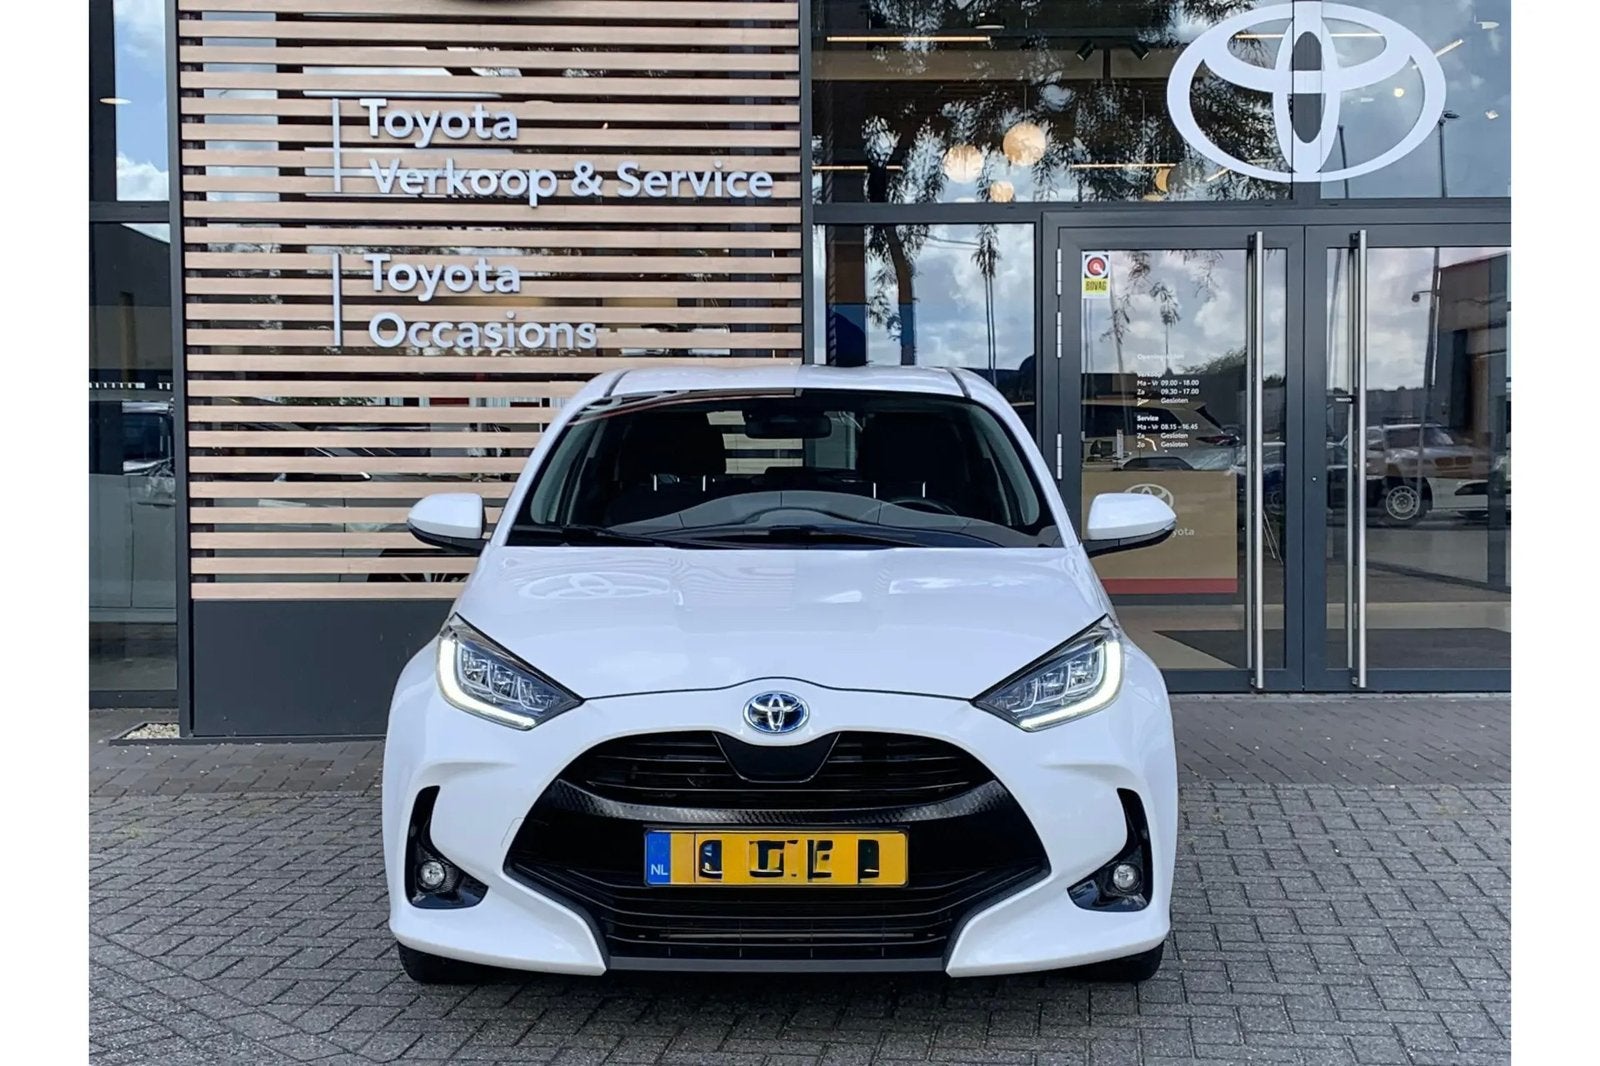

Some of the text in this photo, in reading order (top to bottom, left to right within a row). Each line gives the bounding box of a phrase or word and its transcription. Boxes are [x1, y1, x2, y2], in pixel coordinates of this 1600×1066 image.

[359, 98, 518, 148] Toyota
[368, 158, 774, 208] Verkoop & Service
[363, 253, 521, 302] Toyota
[1085, 281, 1107, 291] BOVAG
[368, 310, 598, 350] Occasions
[1172, 528, 1195, 538] yota
[650, 864, 668, 876] NL
